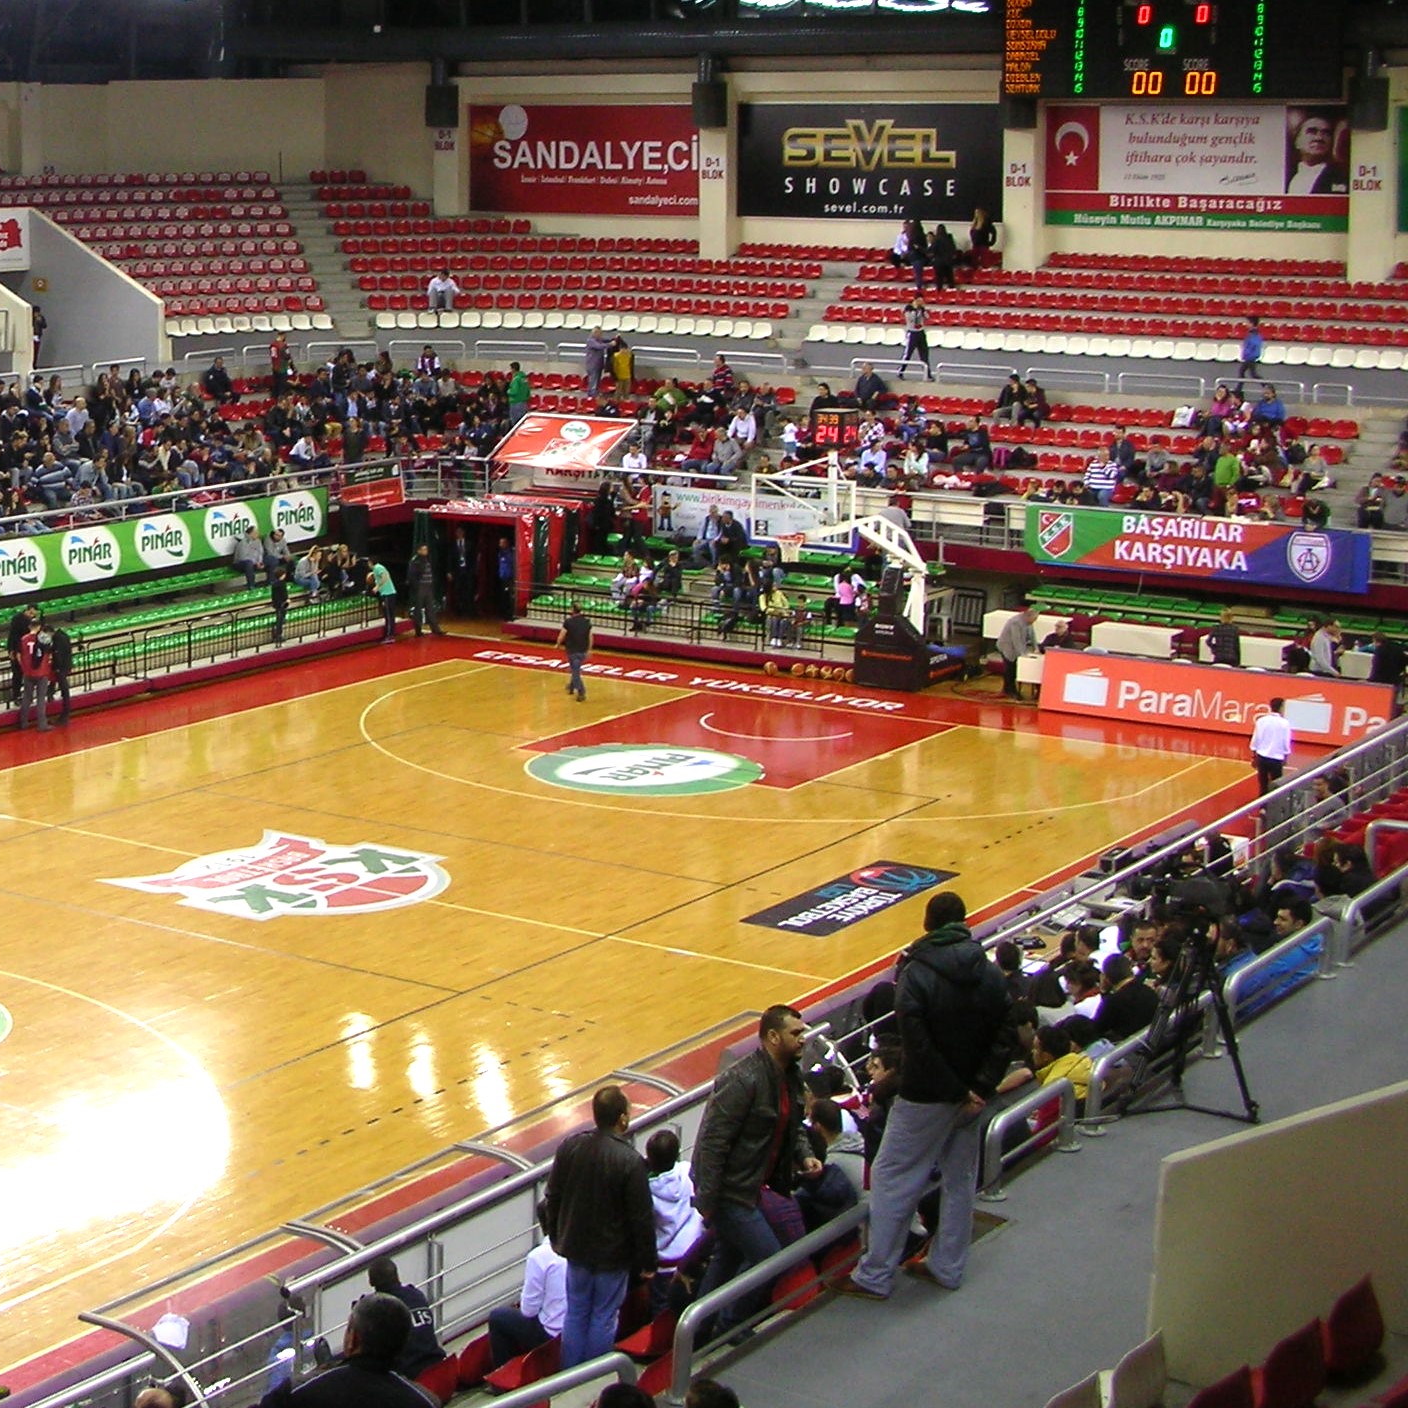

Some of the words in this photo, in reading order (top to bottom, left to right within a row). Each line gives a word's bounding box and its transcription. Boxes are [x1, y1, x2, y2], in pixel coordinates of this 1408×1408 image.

[1137, 5, 1150, 24] 0
[1196, 5, 1209, 23] 0
[1159, 28, 1173, 48] 0
[1123, 59, 1150, 71] SCORE
[1182, 59, 1209, 71] SCORE
[1132, 71, 1163, 94] 00
[1185, 71, 1216, 94] 00
[1179, 112, 1211, 128] karşı
[1213, 112, 1261, 128] karşıya
[434, 140, 455, 151] BLOK
[782, 119, 957, 172] SEVEL
[1128, 131, 1208, 147] bulunduğum
[1211, 131, 1256, 148] gençlik
[1126, 150, 1172, 167] iftihara
[1175, 151, 1197, 167] çok
[701, 169, 724, 181] BLOK
[1359, 165, 1377, 177] D-1
[784, 177, 957, 197] SHOWCASE
[1006, 176, 1031, 188] BLOK
[1352, 179, 1382, 191] BLOK
[628, 194, 699, 207] sandalyeci.com
[823, 202, 905, 215] sevel.com.tr
[1109, 194, 1171, 208] Birlikte
[1177, 195, 1283, 213] Başaracağız
[1073, 213, 1118, 226] Hüseyin
[1153, 214, 1204, 227] AKPINAR
[815, 425, 839, 443] 24
[276, 504, 315, 527] PINAR
[210, 517, 250, 539] PINAR
[1122, 515, 1243, 543] BAŞARILAR
[141, 530, 184, 553] PINAR
[68, 541, 112, 565] PINAR
[1114, 540, 1247, 572] KARŞIYAKA
[777, 886, 881, 928] BASKETBOL
[826, 891, 903, 922] TÜRKİYE
